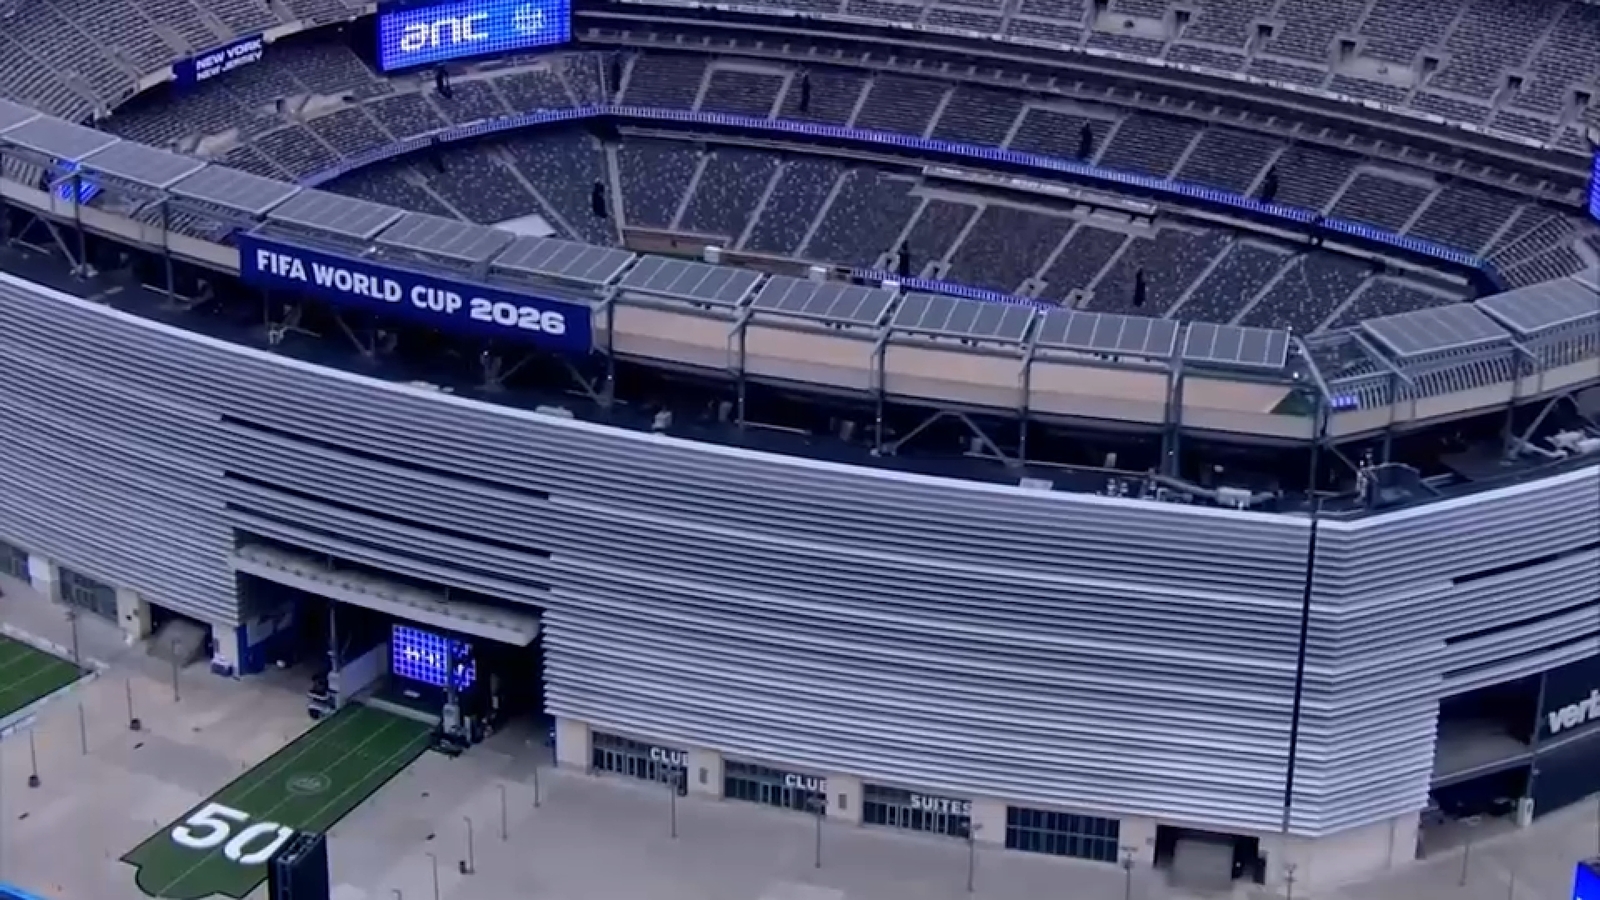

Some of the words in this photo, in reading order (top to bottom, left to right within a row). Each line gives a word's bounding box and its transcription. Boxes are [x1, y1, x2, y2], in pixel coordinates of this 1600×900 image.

[196, 51, 225, 70] NEW
[226, 39, 262, 58] YORK
[196, 65, 221, 81] NEW
[256, 249, 307, 282] FIFA
[312, 262, 402, 302] WORLD
[411, 285, 462, 314] CUP
[469, 297, 566, 335] 2026
[911, 794, 972, 815] SUITES
[171, 802, 295, 864] 50
